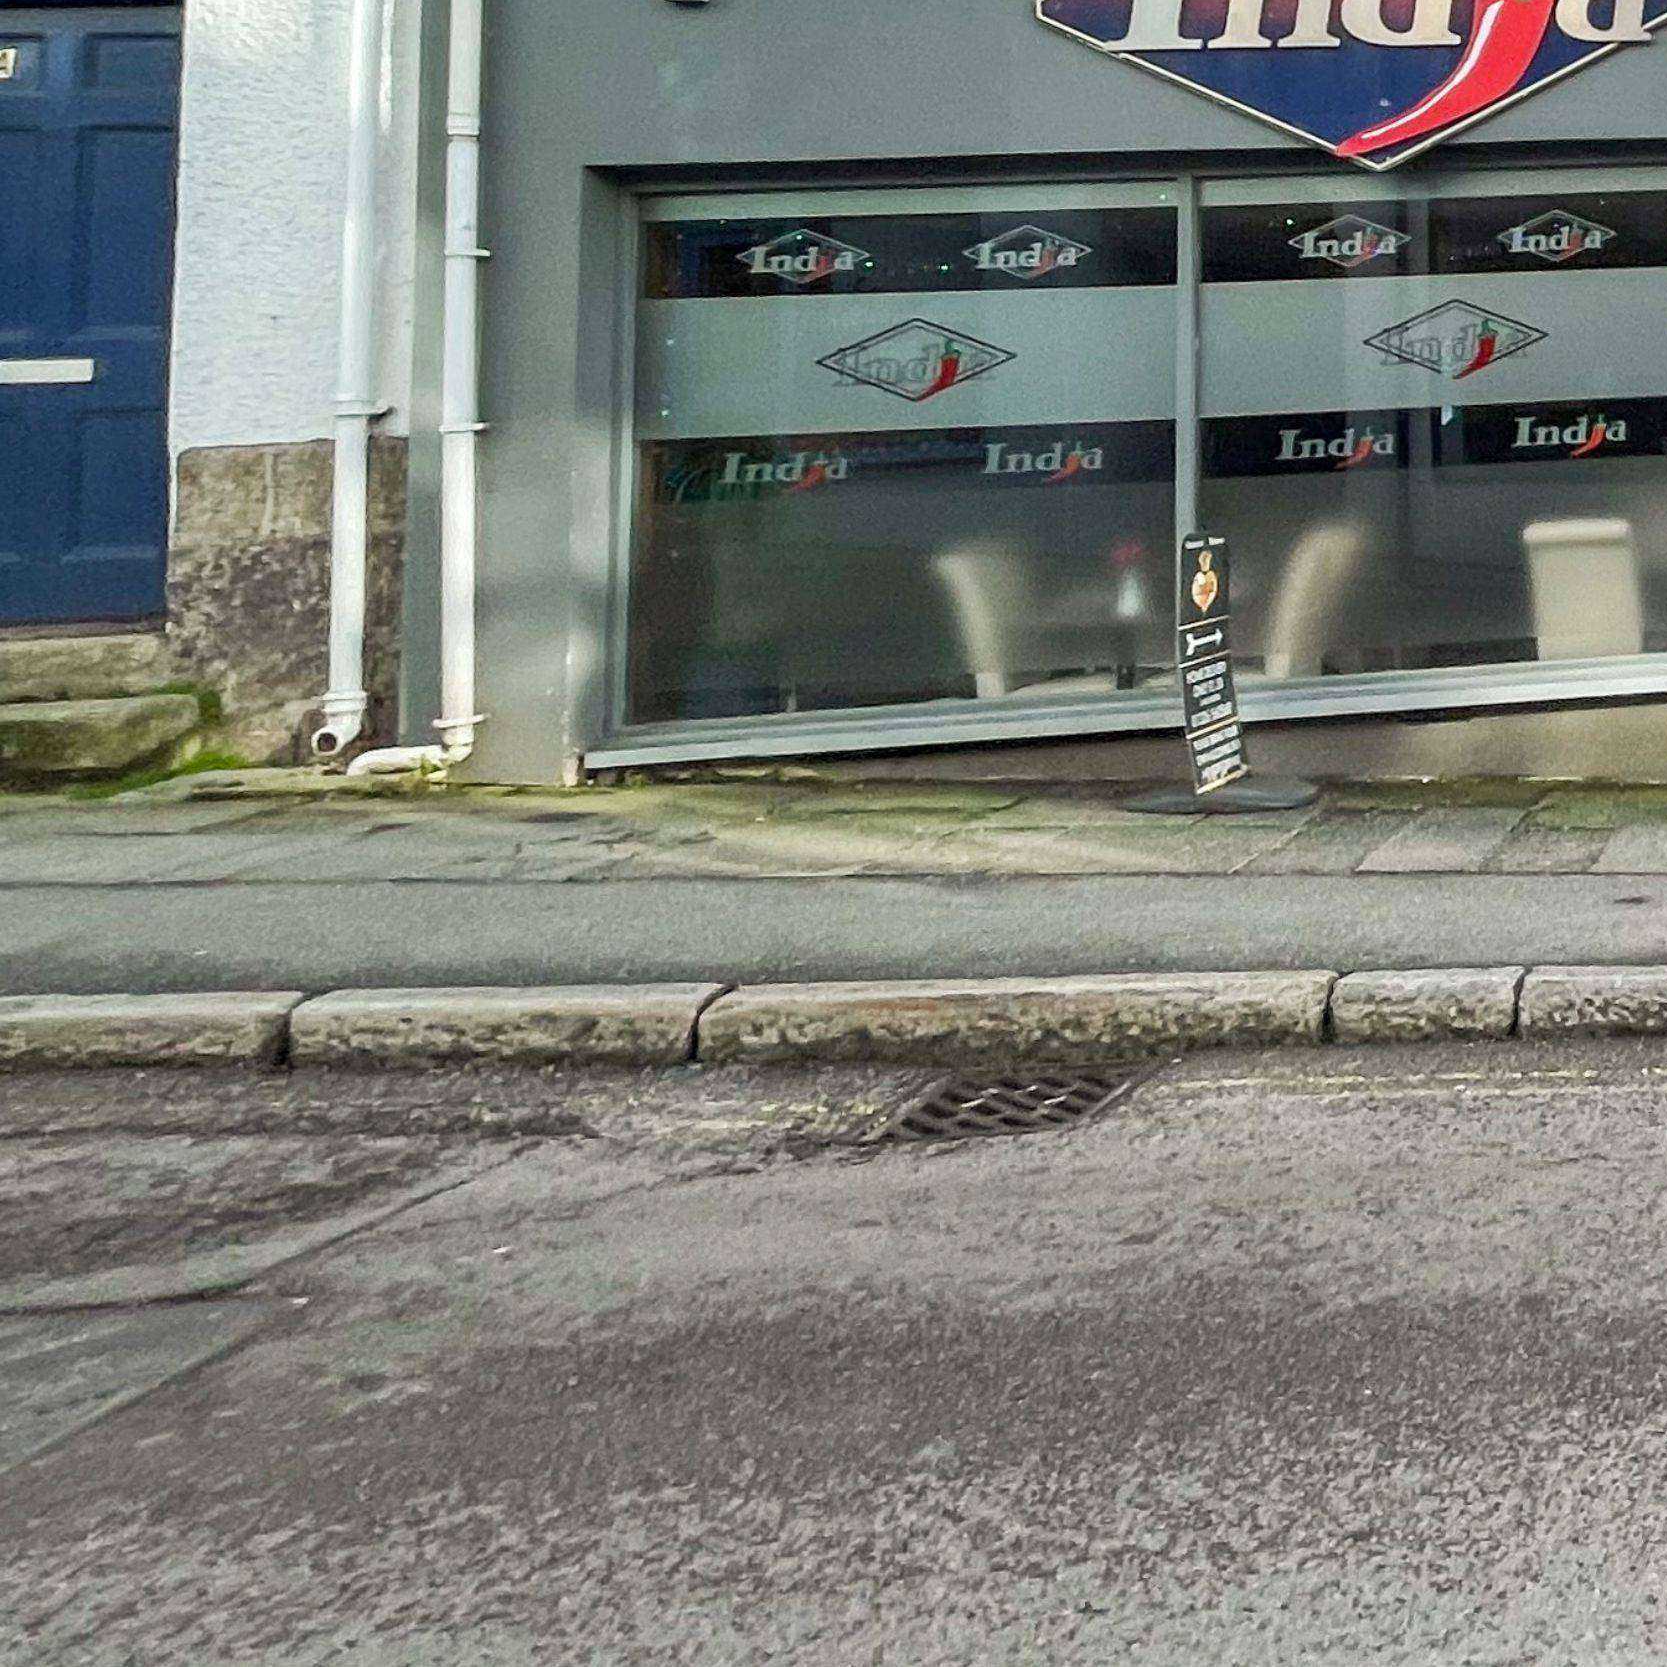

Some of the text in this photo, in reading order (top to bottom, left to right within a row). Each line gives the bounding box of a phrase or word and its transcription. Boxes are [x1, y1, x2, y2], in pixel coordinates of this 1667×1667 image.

[749, 243, 854, 282] India
[974, 238, 1077, 277] India
[1299, 226, 1396, 265] India
[1508, 222, 1602, 262] India
[1273, 425, 1395, 471] India
[1512, 413, 1627, 460] India
[718, 447, 849, 494] India
[983, 440, 1102, 485] India
